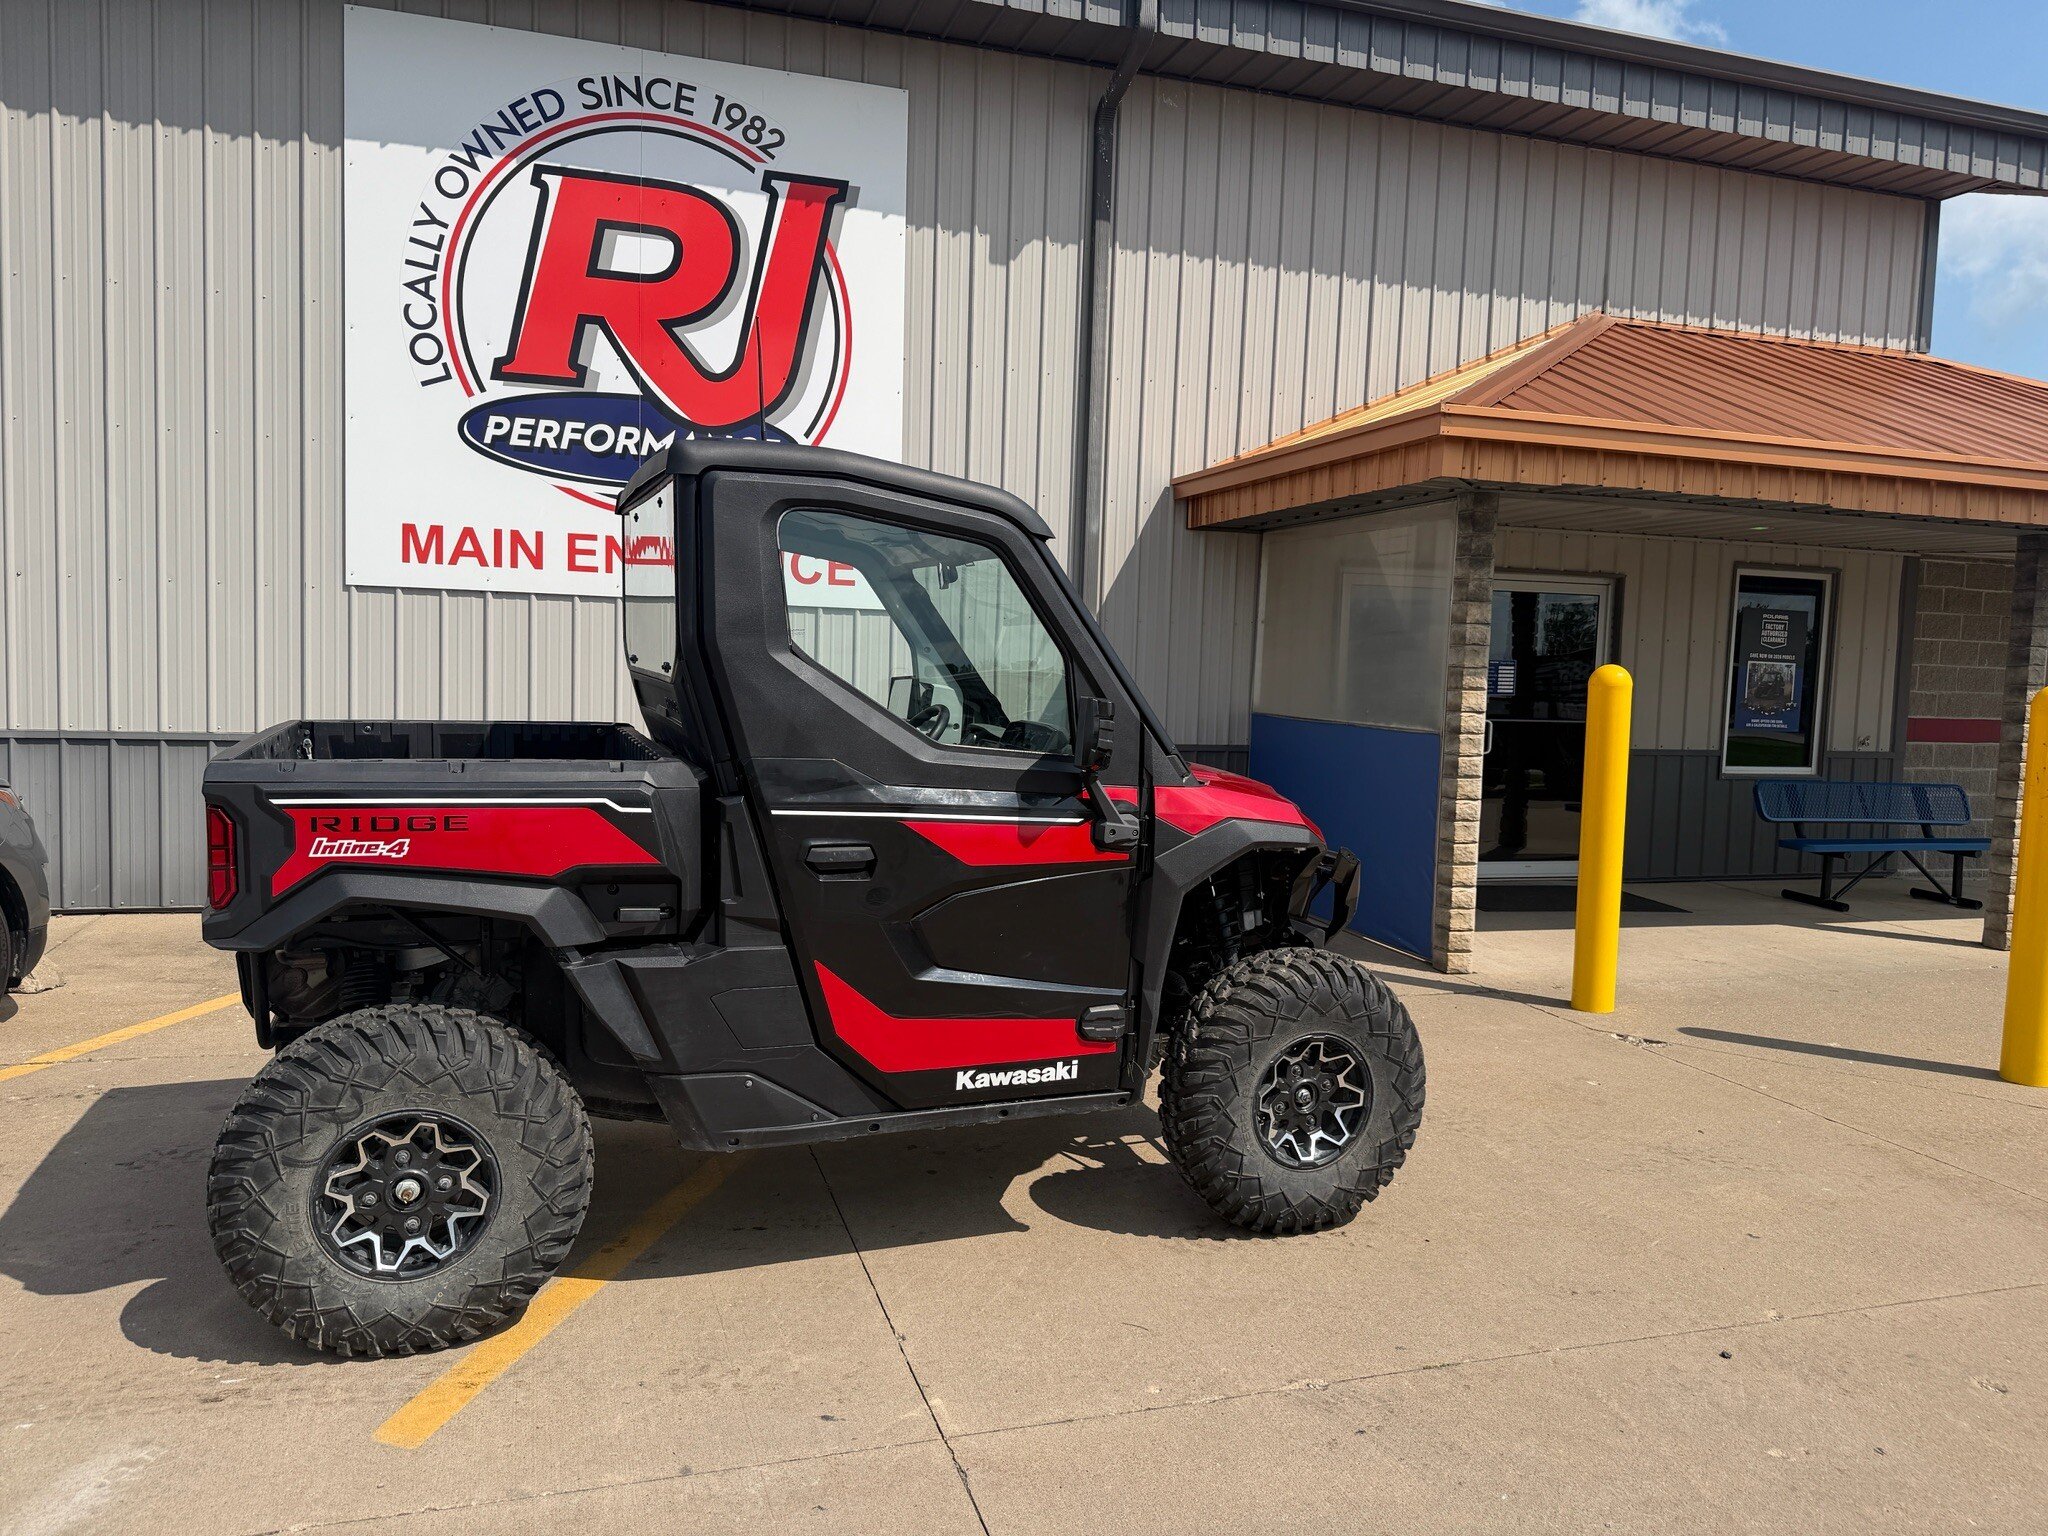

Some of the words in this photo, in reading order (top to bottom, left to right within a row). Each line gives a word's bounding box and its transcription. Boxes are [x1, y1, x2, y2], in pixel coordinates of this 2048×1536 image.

[402, 201, 452, 387] LOCALLY
[435, 88, 565, 199] OWNED
[577, 75, 697, 117] SINCE
[712, 94, 785, 160] 1982
[490, 163, 849, 428] RJ
[483, 414, 780, 457] PERFORM
[401, 523, 543, 570] MAIN
[310, 815, 469, 832] RIDGE
[308, 837, 410, 858] Inline-4
[955, 1059, 1078, 1090] Kawasaki
